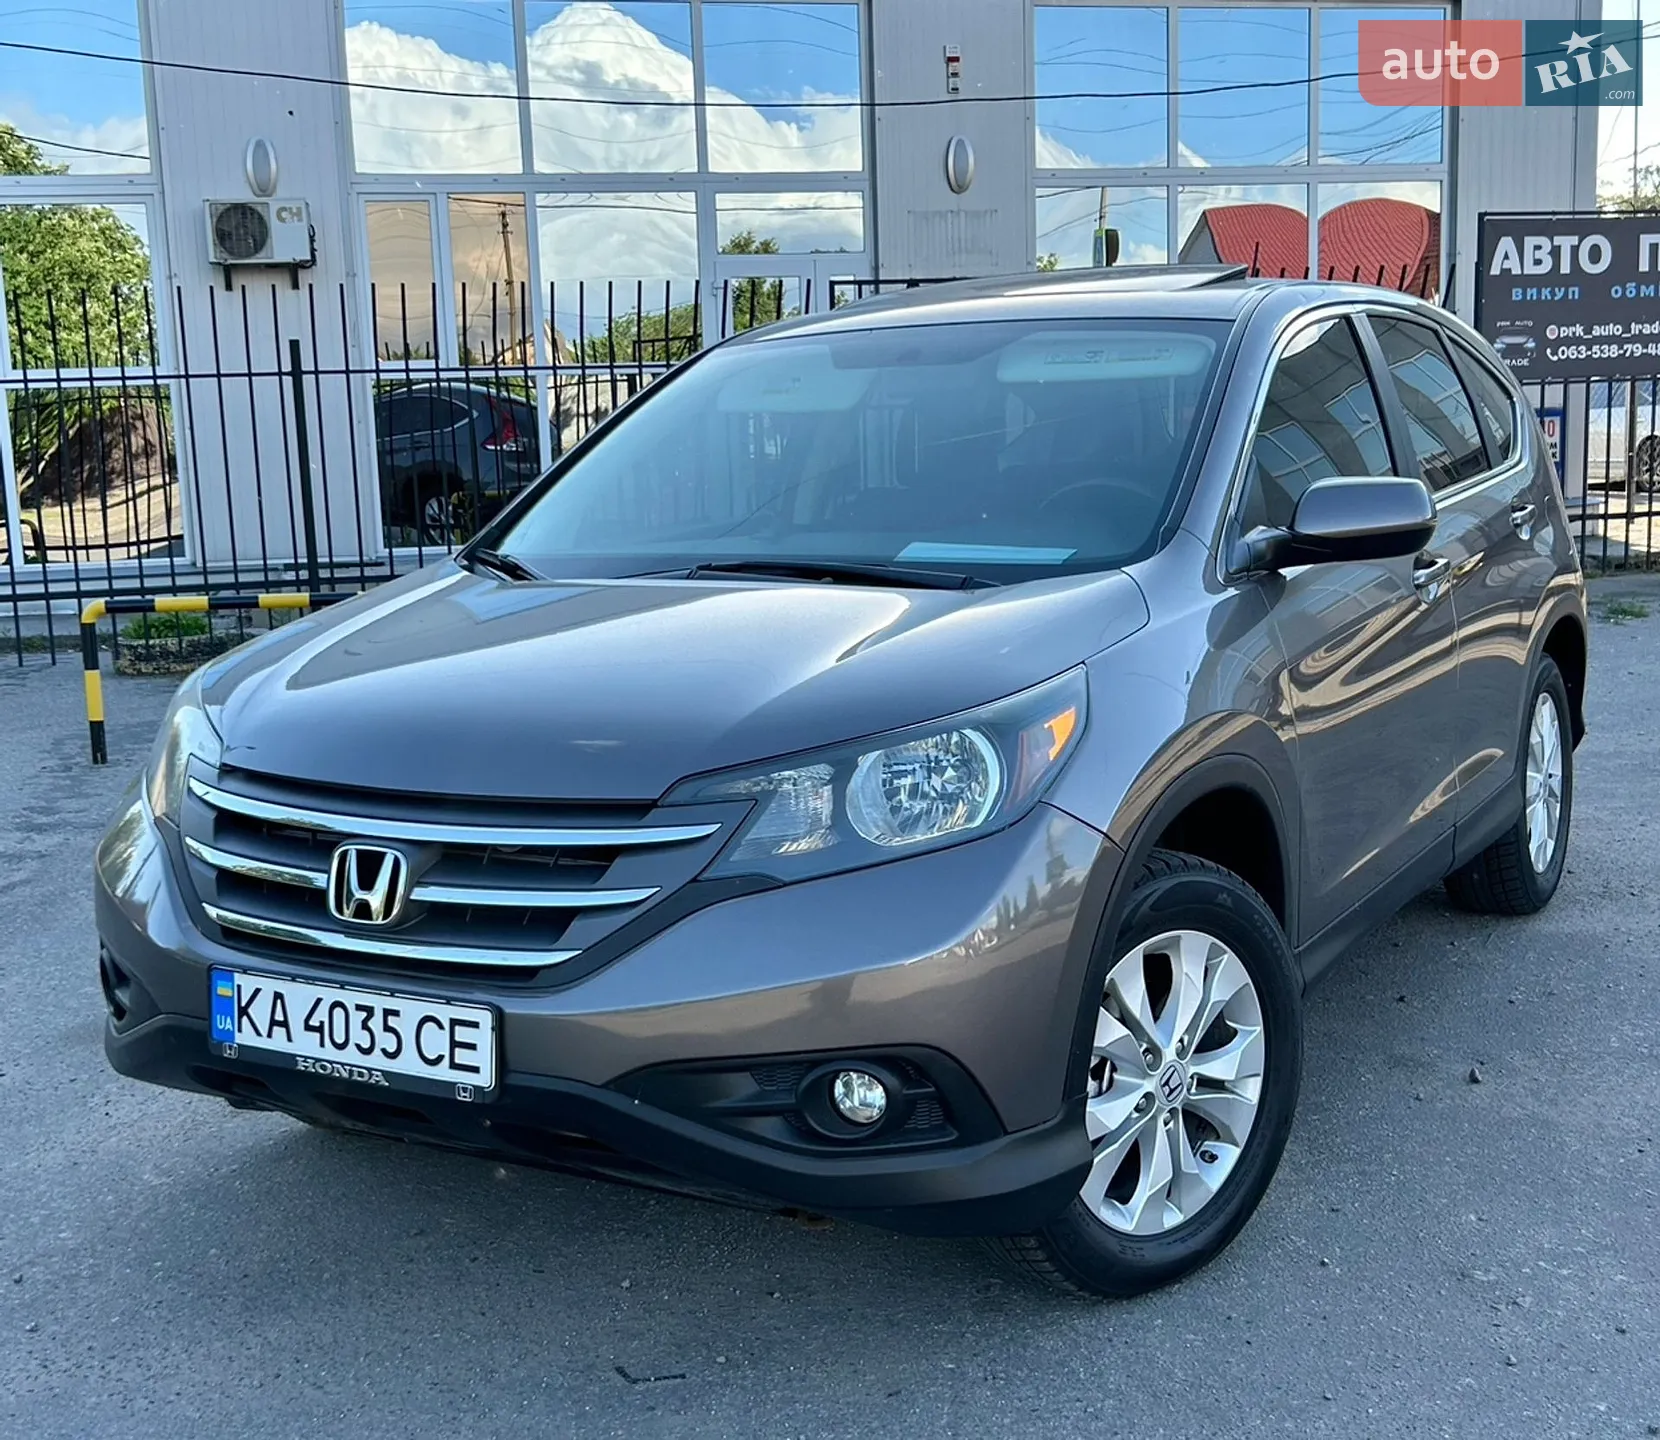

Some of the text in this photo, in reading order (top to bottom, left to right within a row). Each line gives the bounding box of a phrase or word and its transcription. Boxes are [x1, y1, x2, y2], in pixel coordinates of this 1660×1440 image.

[1489, 234, 1612, 275] АВТО
[1511, 286, 1580, 300] викуп
[1559, 321, 1660, 338] prk_auto_trad
[216, 1014, 234, 1032] UA
[236, 984, 481, 1074] KA 4035 CE
[296, 1056, 390, 1087] HONDA
